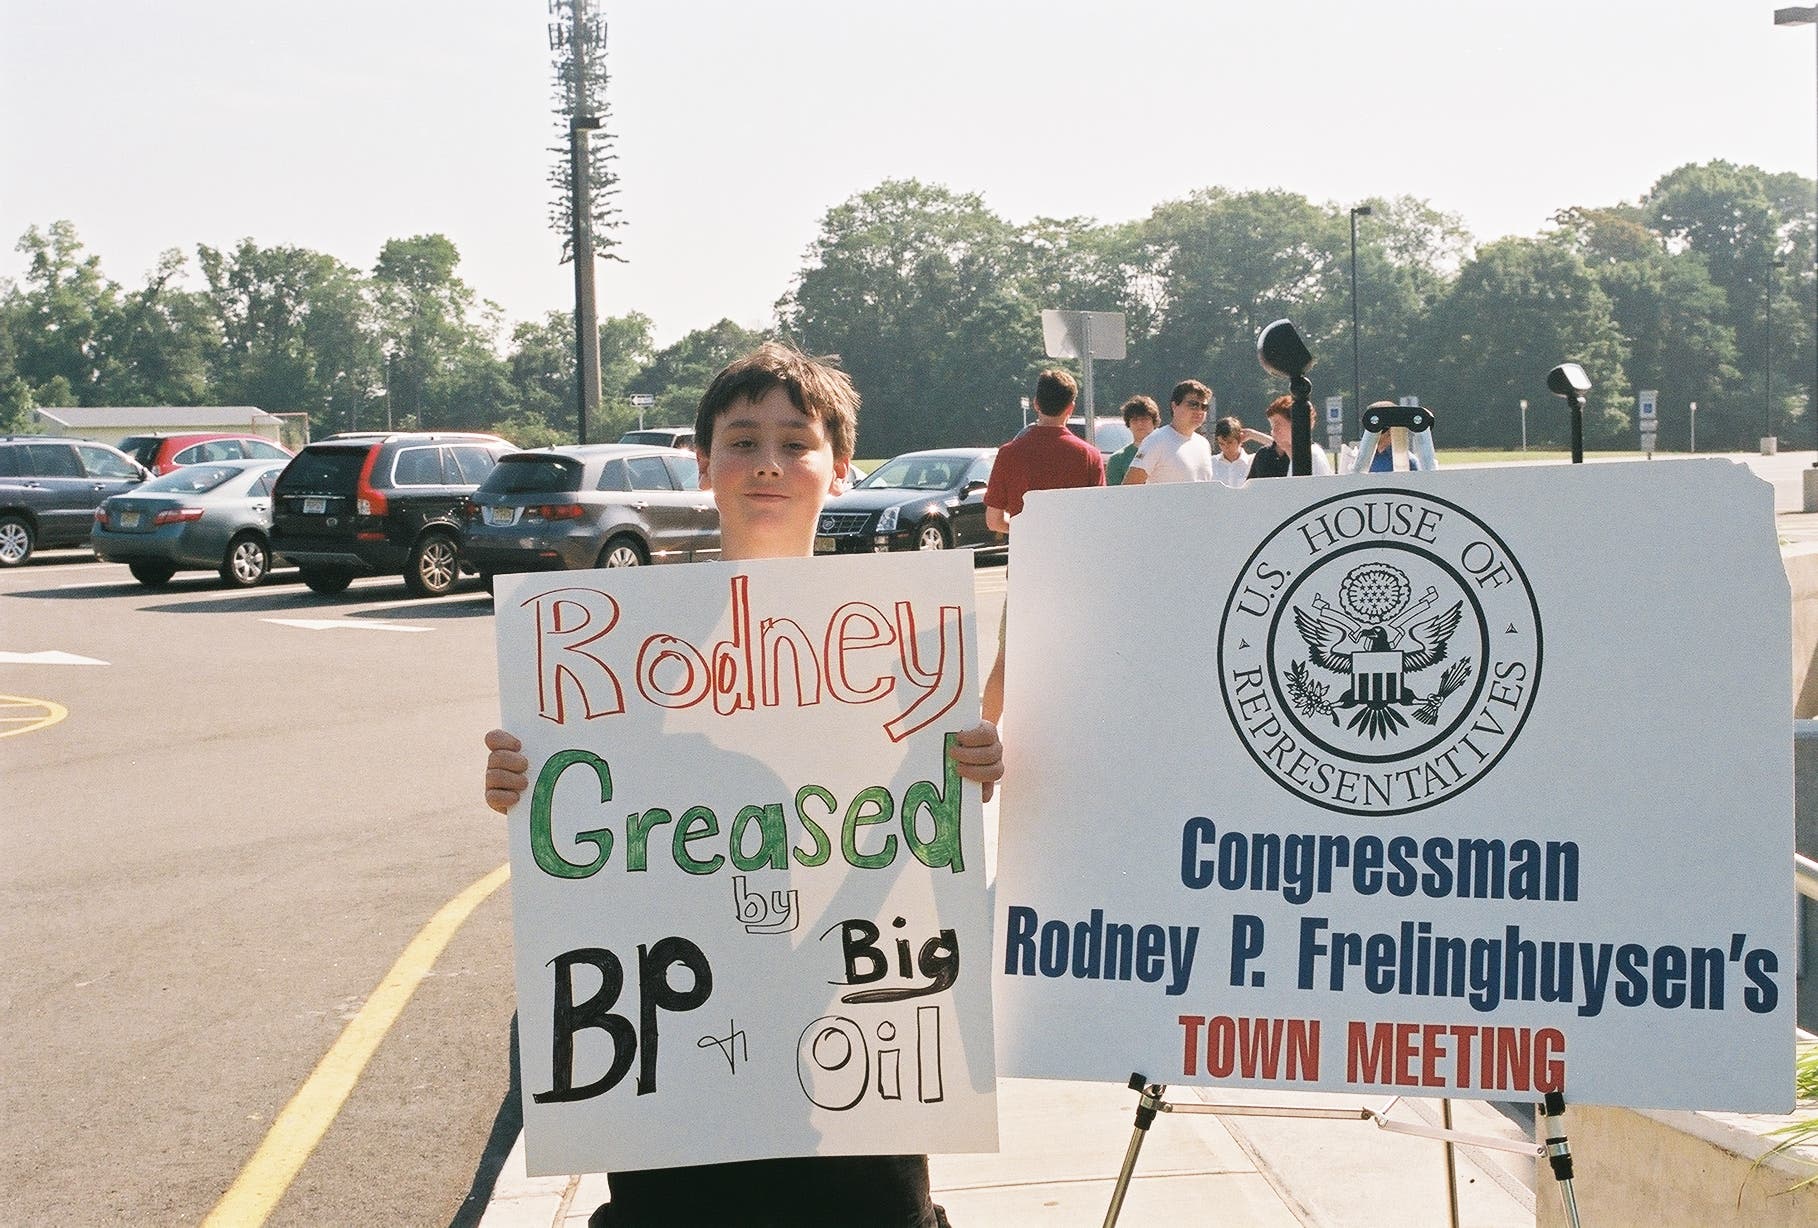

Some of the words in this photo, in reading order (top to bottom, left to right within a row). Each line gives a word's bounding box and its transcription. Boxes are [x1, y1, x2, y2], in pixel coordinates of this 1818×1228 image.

[1236, 562, 1292, 617] U.S.
[1297, 502, 1443, 555] HOUSE
[1461, 541, 1513, 589] OF
[521, 575, 964, 743] Rodney
[1233, 661, 1527, 807] REPRESENTATIVES
[530, 732, 965, 879] Greased
[1181, 817, 1579, 904] Congressman
[732, 876, 799, 934] by
[820, 916, 960, 1004] Big
[1004, 905, 1200, 995] Rodney
[1230, 914, 1266, 988] P.
[1297, 916, 1779, 1016] Frelinghuysen's
[533, 936, 713, 1104] BP
[797, 1006, 944, 1111] Oil
[1178, 1015, 1320, 1082] TOWN
[1346, 1021, 1566, 1093] MEETING
